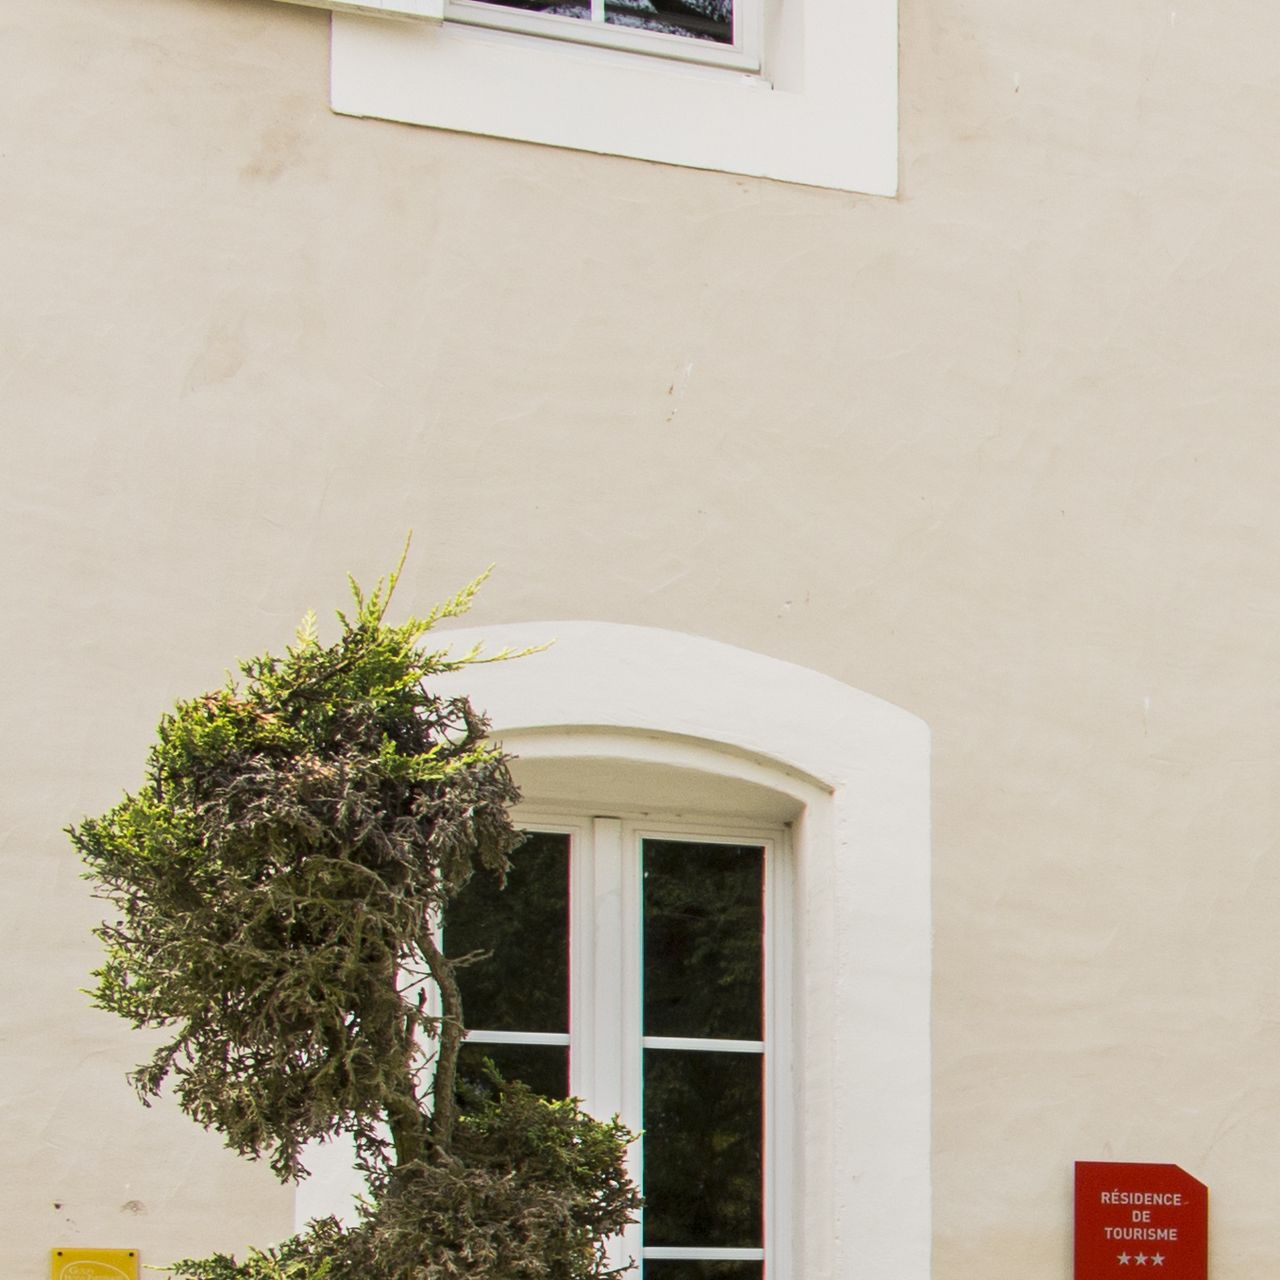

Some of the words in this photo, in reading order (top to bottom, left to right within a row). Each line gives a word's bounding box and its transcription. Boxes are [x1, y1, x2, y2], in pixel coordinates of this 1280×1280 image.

[1101, 1189, 1182, 1206] RÉSIDENCE
[1132, 1210, 1151, 1223] DE
[1104, 1227, 1178, 1241] TOURISME
